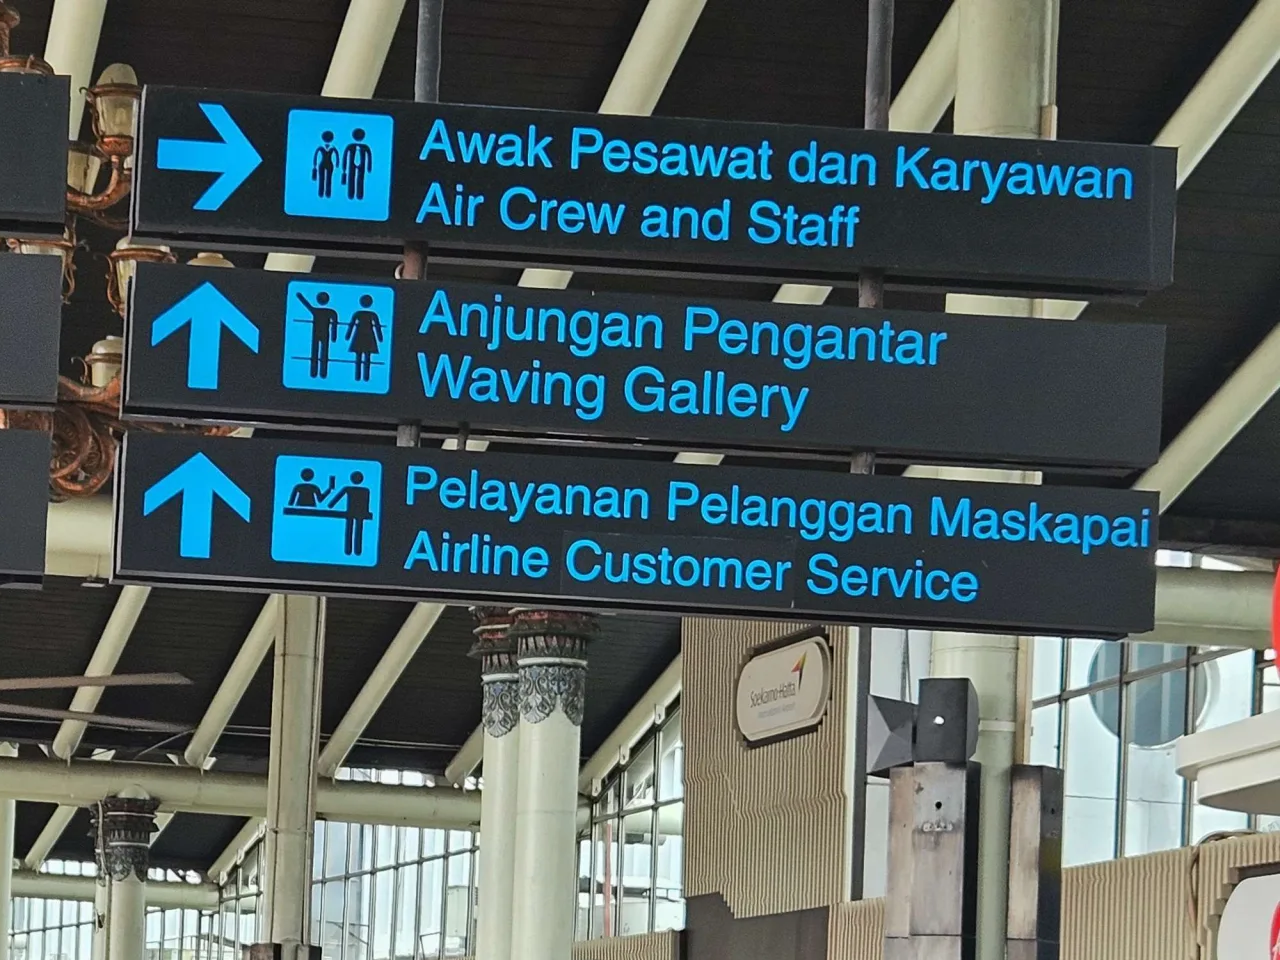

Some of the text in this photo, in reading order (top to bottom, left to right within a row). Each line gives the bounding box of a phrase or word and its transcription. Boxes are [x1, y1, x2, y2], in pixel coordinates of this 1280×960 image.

[419, 119, 1133, 204] Awak Pesawat dan Karyawan
[416, 181, 860, 247] Air Crew and Staff
[419, 289, 948, 370] Anjungan Pengantar
[417, 352, 809, 432] Waving Gallery
[406, 465, 1150, 555] Pelayanan Pelanggan Maskapai
[404, 530, 979, 602] Airline Customer Service
